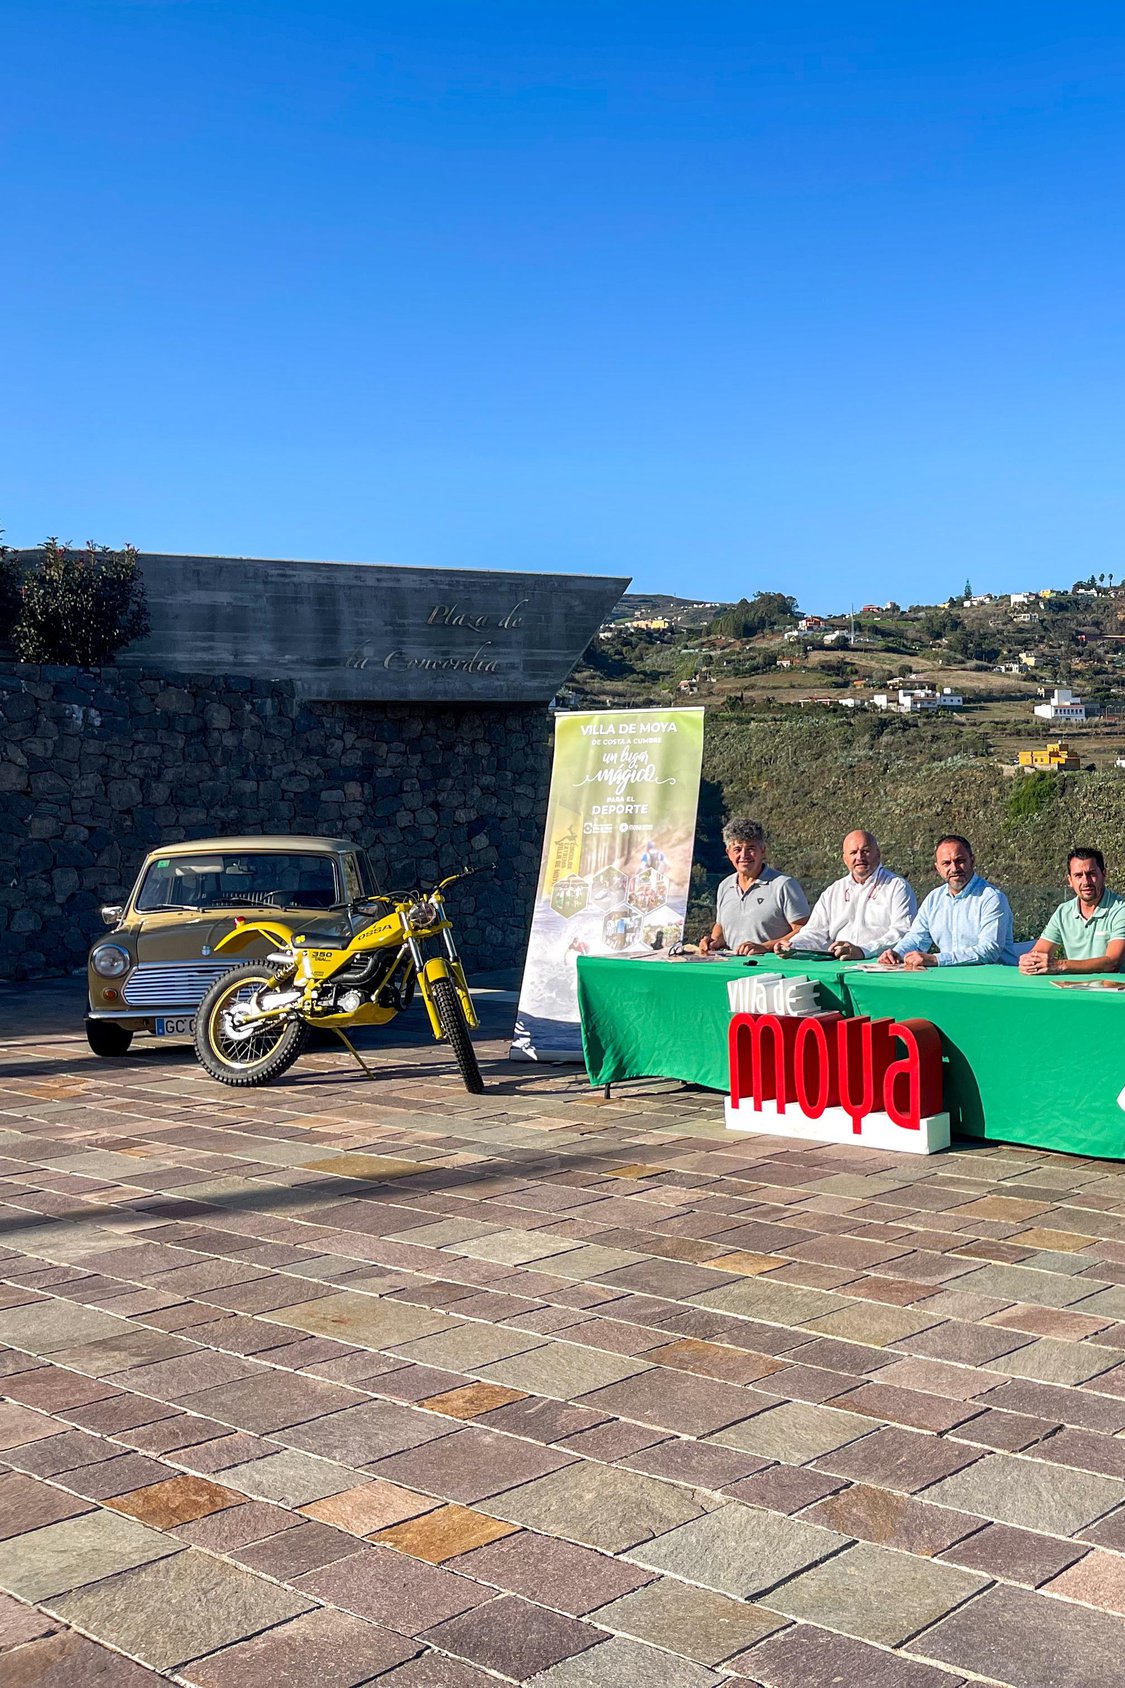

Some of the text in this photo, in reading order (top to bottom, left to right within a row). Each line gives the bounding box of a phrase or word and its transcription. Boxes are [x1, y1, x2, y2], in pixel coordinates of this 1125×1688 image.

[426, 599, 529, 633] Plaza de
[345, 639, 498, 673] la Concordia
[580, 721, 677, 736] VILLA DE MOYA
[602, 744, 649, 769] un lugar
[573, 763, 676, 796] mágico
[592, 804, 649, 815] DEPORTE
[358, 924, 392, 941] OSSA
[727, 976, 799, 1016] villa de
[728, 1012, 921, 1135] moya
